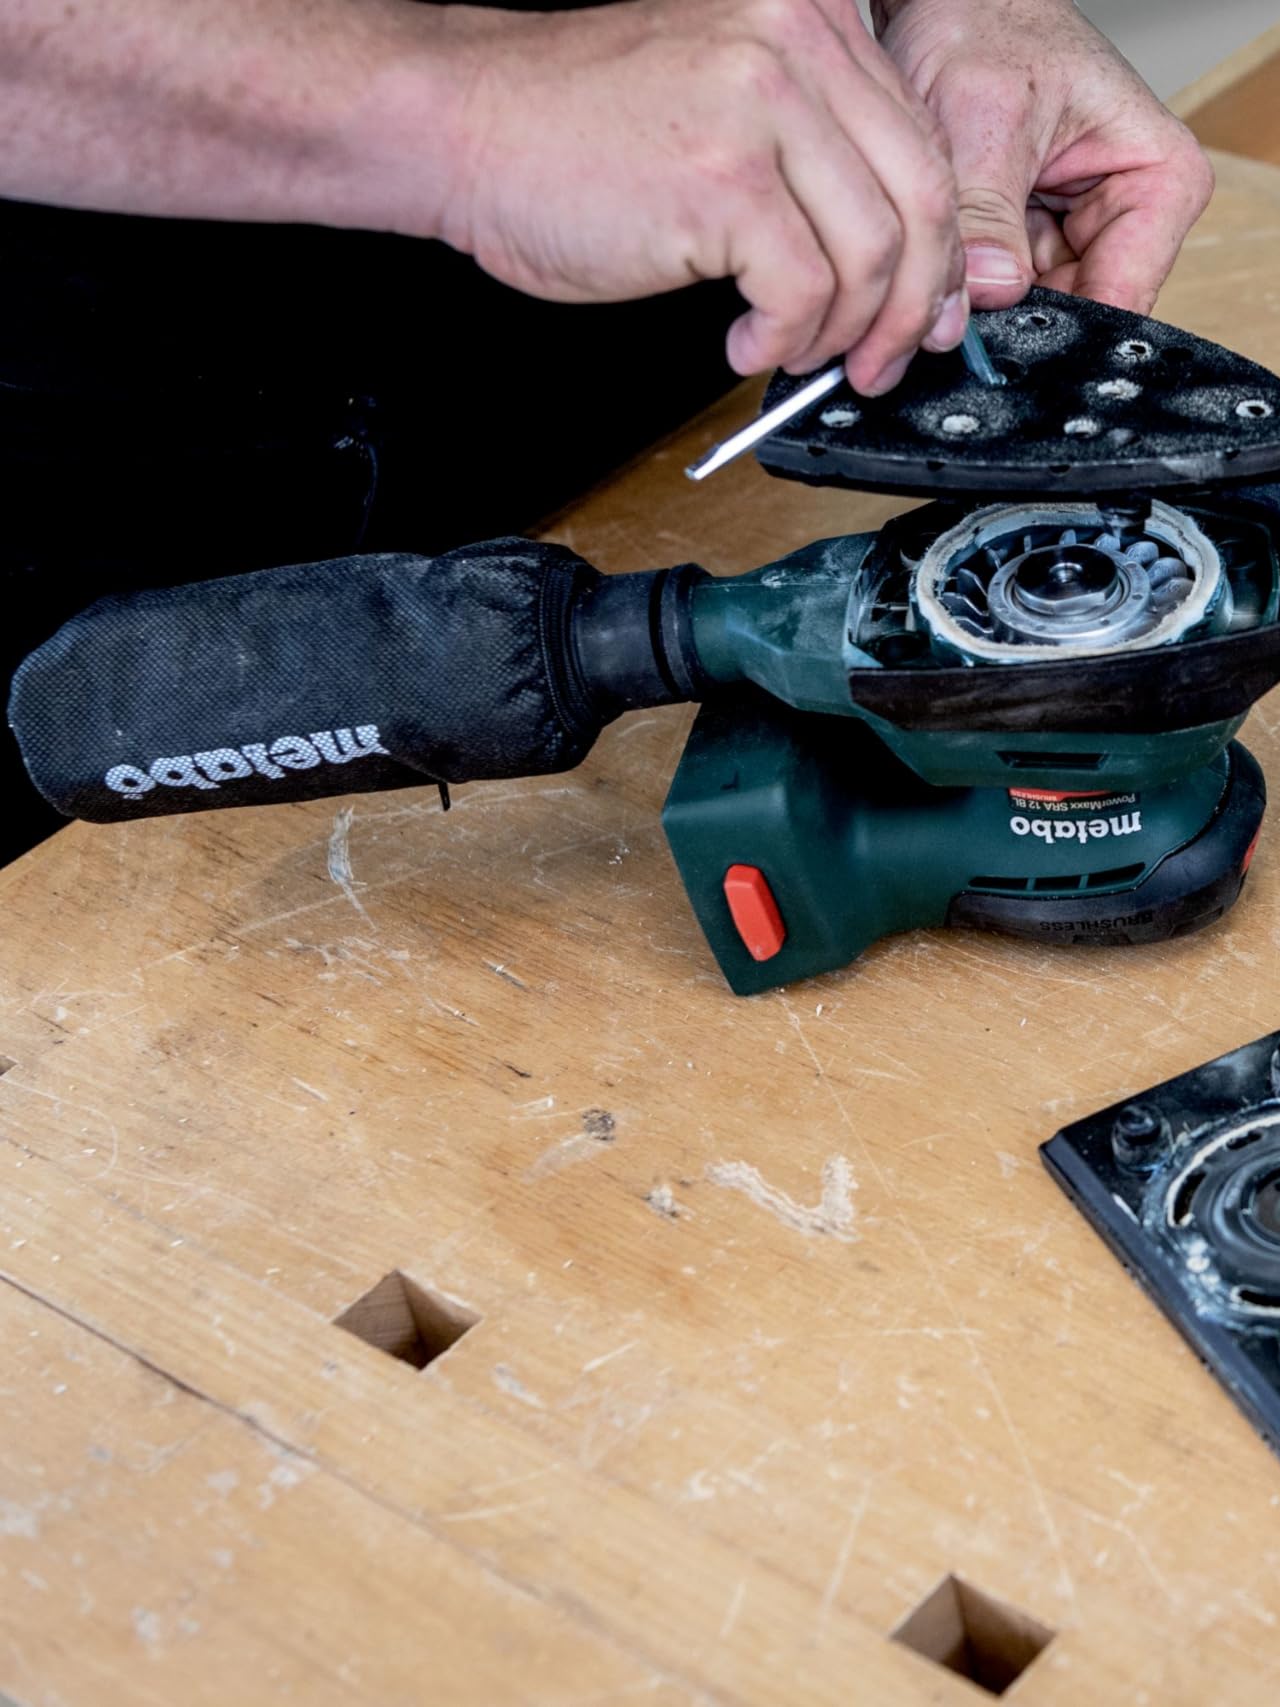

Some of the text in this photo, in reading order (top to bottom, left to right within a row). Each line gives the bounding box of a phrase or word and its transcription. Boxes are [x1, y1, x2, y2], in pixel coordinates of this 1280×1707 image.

[104, 724, 391, 791] metabo
[1013, 793, 1136, 812] PowerMaxx SRA 12 BL
[1009, 811, 1143, 844] metabo
[1039, 909, 1155, 931] BRUSHLESS
